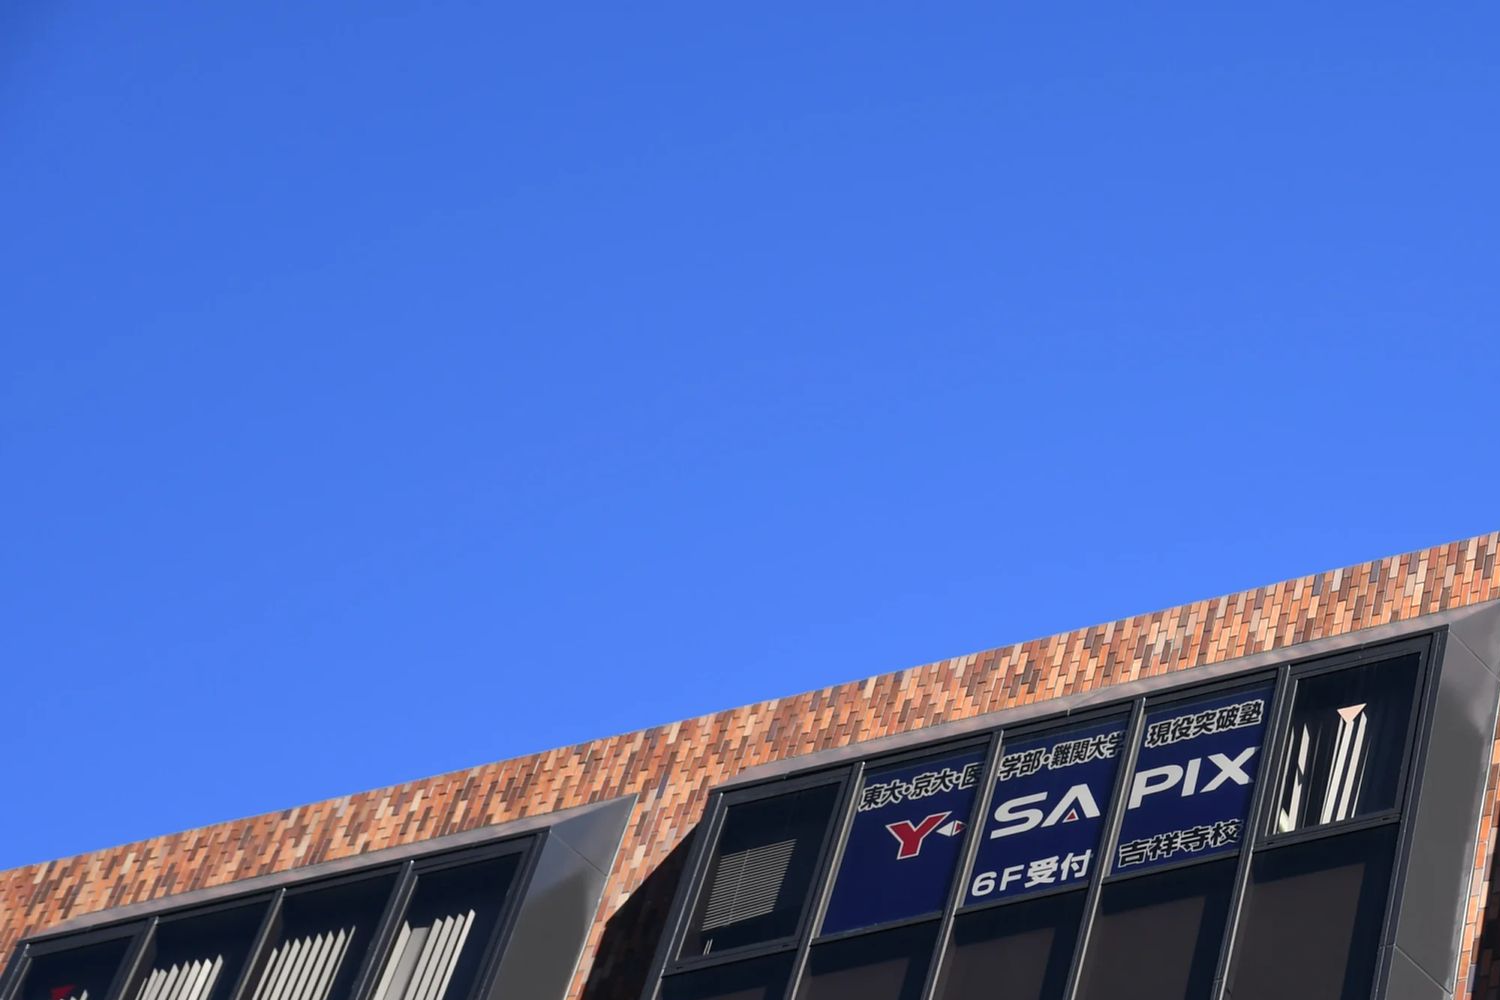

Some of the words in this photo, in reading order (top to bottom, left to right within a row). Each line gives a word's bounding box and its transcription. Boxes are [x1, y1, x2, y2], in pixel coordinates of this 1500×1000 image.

[1118, 819, 1243, 868] 吉祥寺校
[971, 849, 1093, 897] 6F受付
